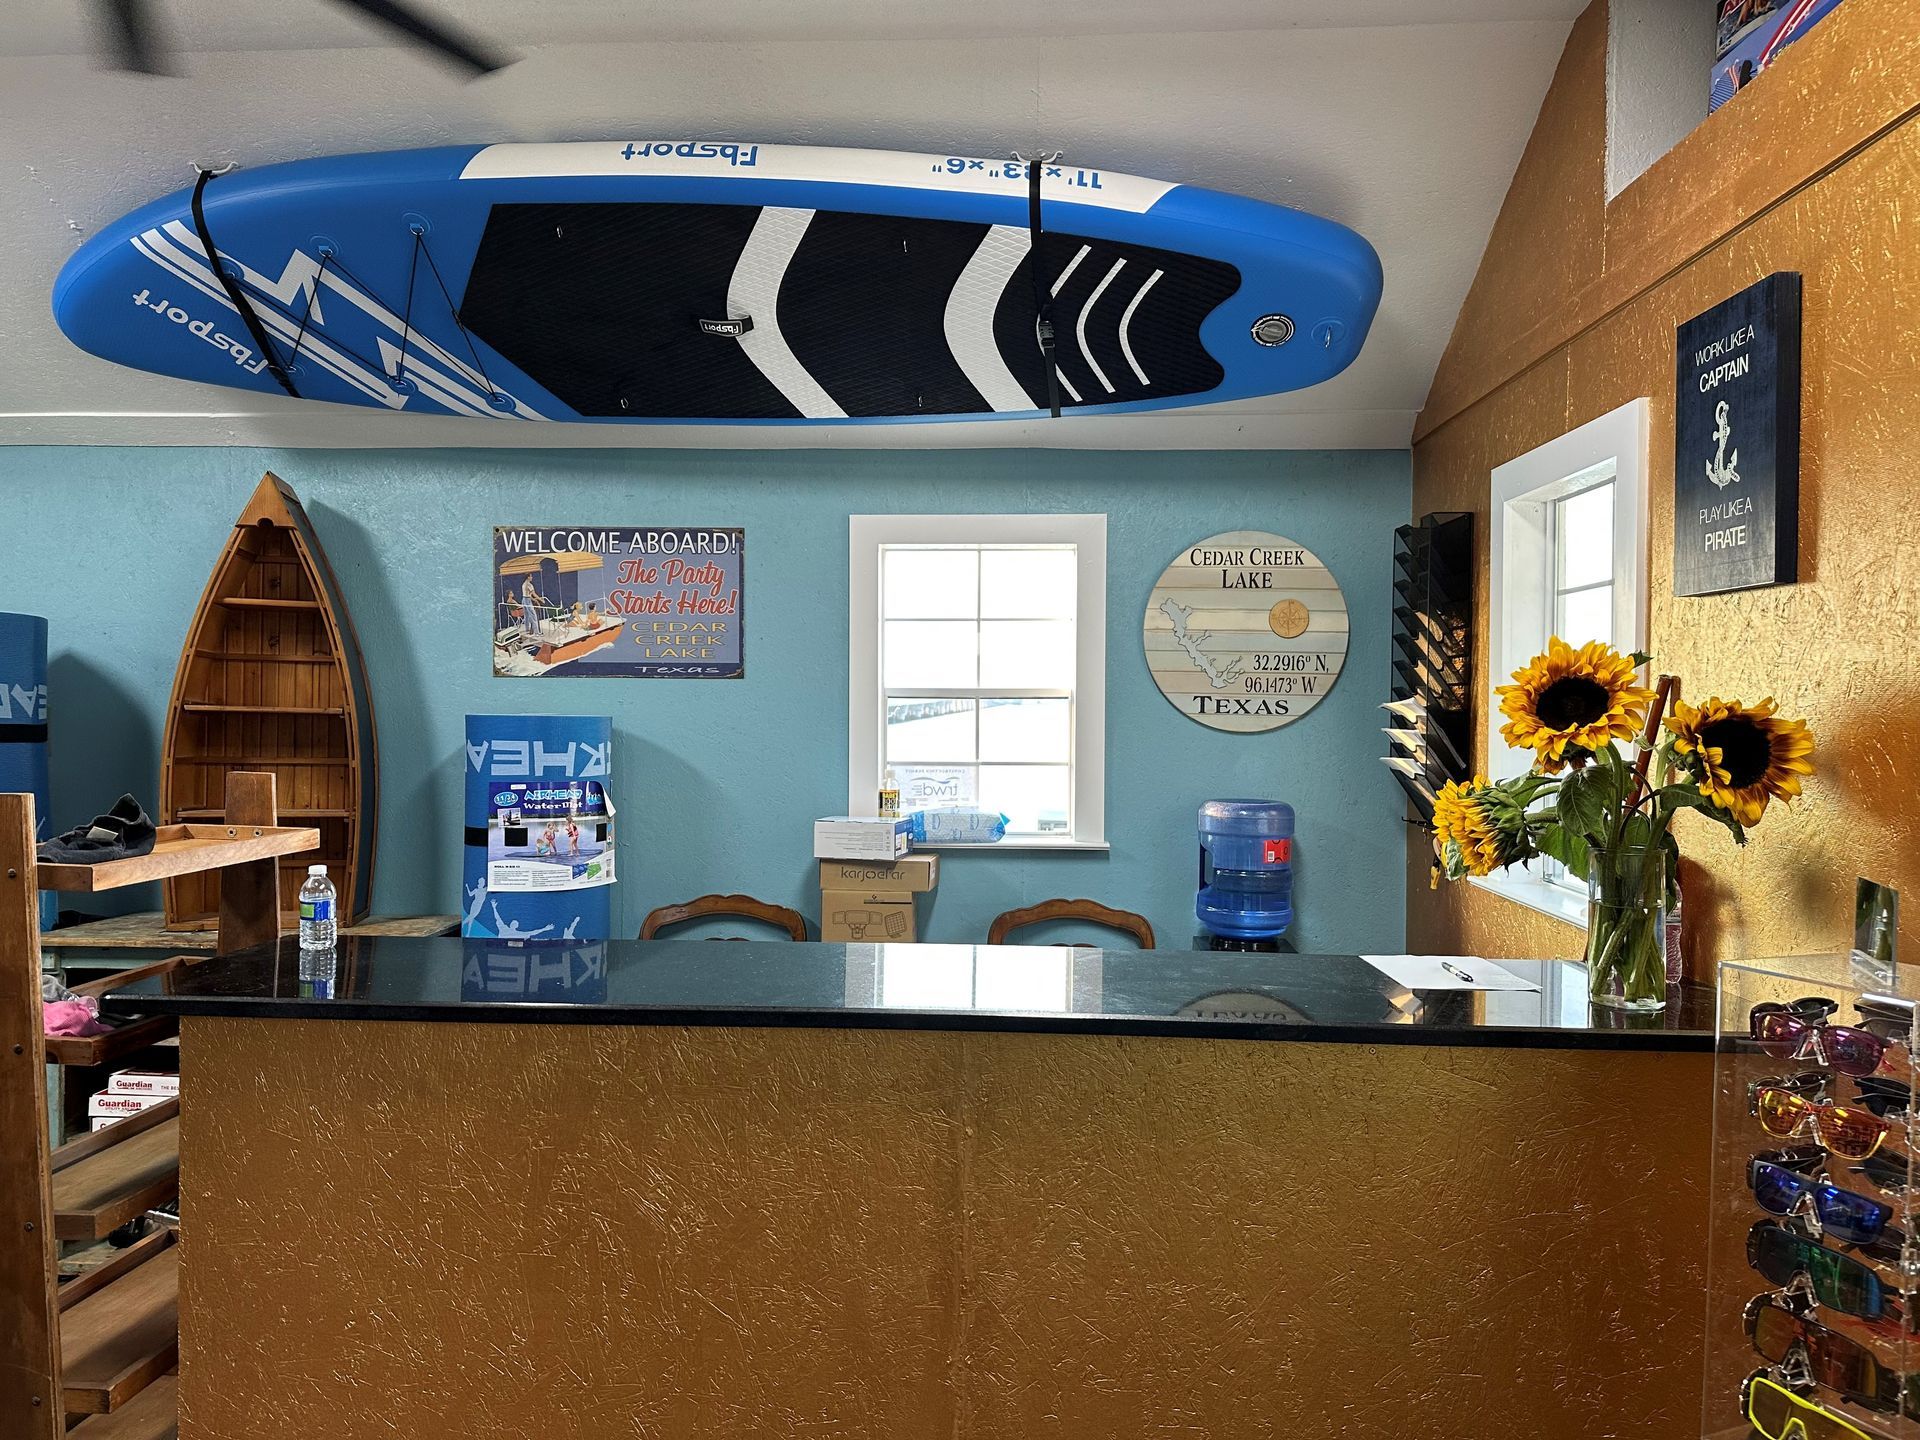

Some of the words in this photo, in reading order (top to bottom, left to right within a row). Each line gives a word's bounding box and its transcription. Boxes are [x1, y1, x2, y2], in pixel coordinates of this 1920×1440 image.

[621, 142, 758, 166] Fbsport
[132, 289, 269, 374] Fbsport
[1695, 338, 1725, 366] WORK
[1725, 327, 1746, 352] LIKE
[1746, 324, 1755, 342] A
[1699, 353, 1749, 393] CAPTAIN
[1699, 504, 1723, 525] PLAY
[1723, 498, 1744, 518] LIKE
[1744, 496, 1753, 514] A
[502, 531, 621, 554] WELCOME
[628, 532, 737, 554] ABOARD!
[1705, 525, 1746, 552] PIRATE
[1190, 548, 1244, 566] CEDAR
[1250, 548, 1305, 566] CREEK
[616, 558, 658, 585] The
[661, 558, 726, 597] Party
[1222, 569, 1273, 589] LAKE
[606, 589, 672, 616] Starts
[677, 590, 739, 616] Here!
[631, 622, 728, 632] CEDAR
[634, 635, 724, 645] CREEK
[645, 648, 715, 658] LAKE
[634, 666, 720, 674] Texas
[1302, 676, 1317, 693] W
[1193, 695, 1289, 715] TEXAS
[524, 789, 583, 800] AIRHEAD
[841, 866, 906, 882] karjoefar
[116, 1080, 152, 1088] Guardian
[98, 1100, 142, 1108] Guardian
